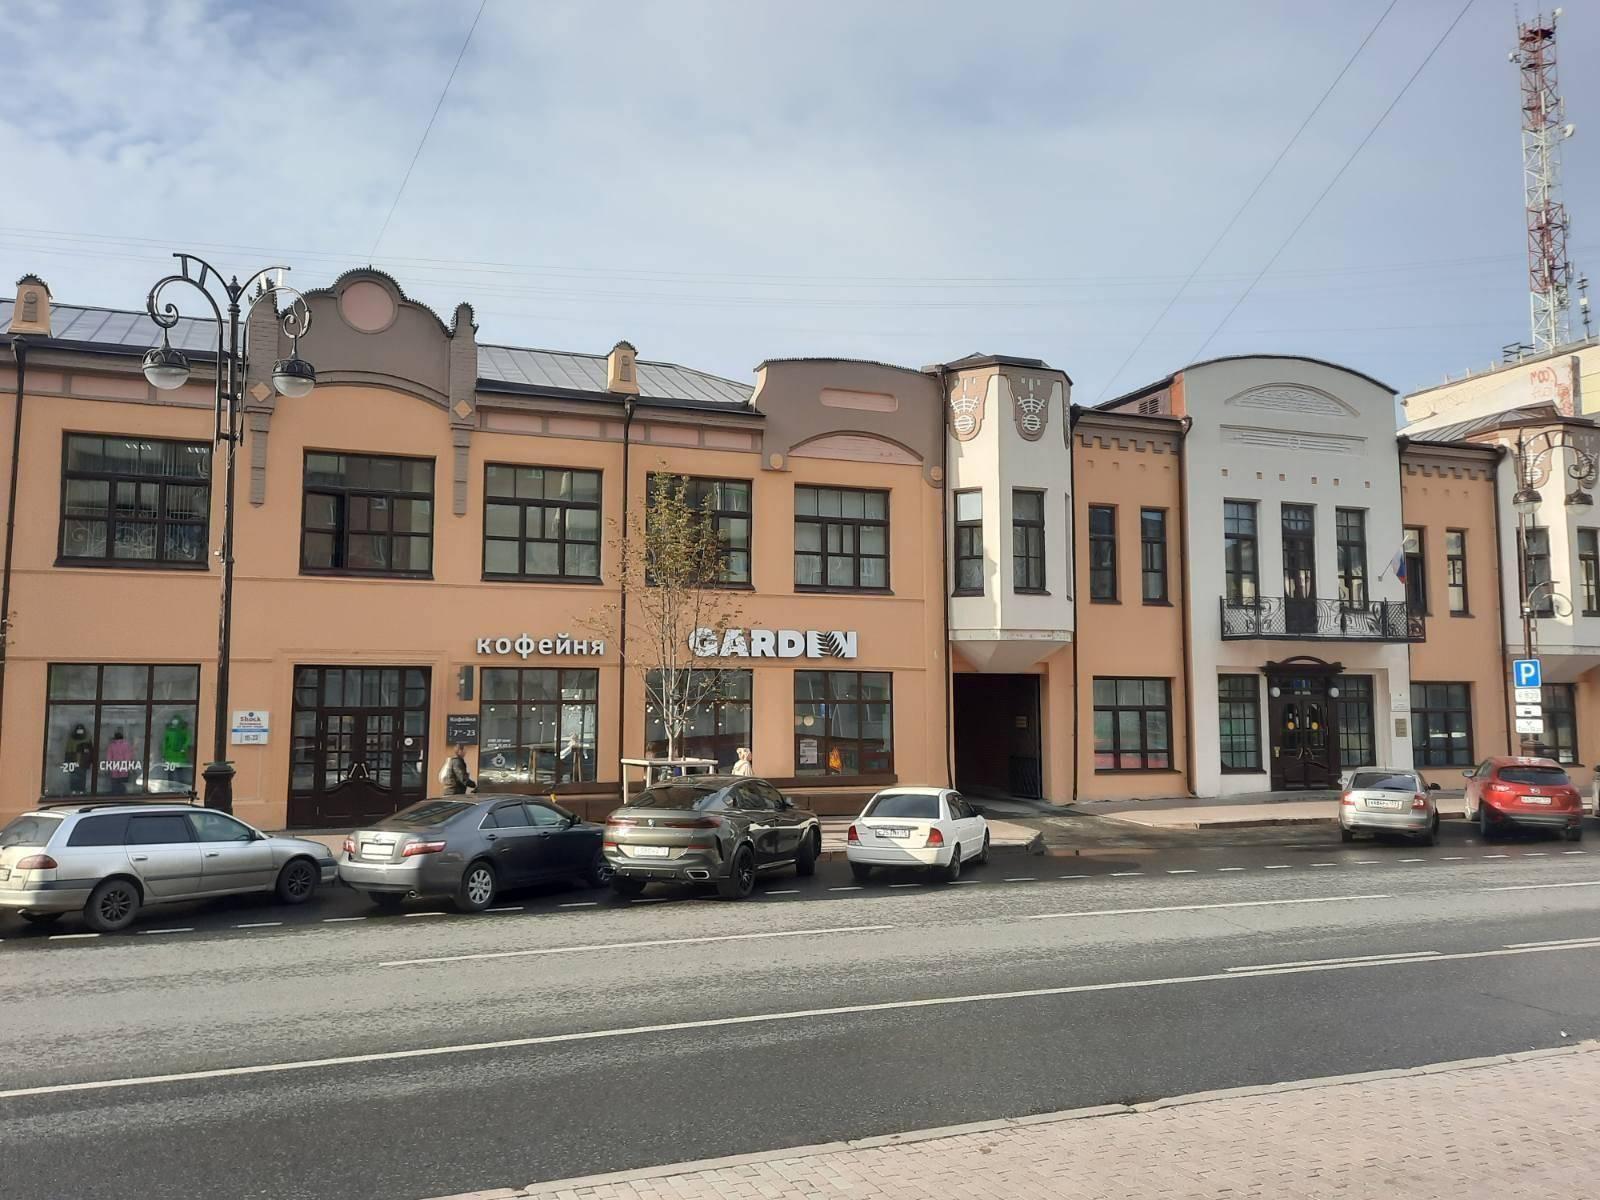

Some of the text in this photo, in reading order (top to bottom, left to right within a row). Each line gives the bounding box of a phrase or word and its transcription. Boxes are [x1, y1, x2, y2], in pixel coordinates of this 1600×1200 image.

[477, 632, 605, 659] кофейня
[688, 627, 858, 658] GARDEN
[1520, 663, 1535, 685] P
[100, 760, 142, 772] СКИДКА
